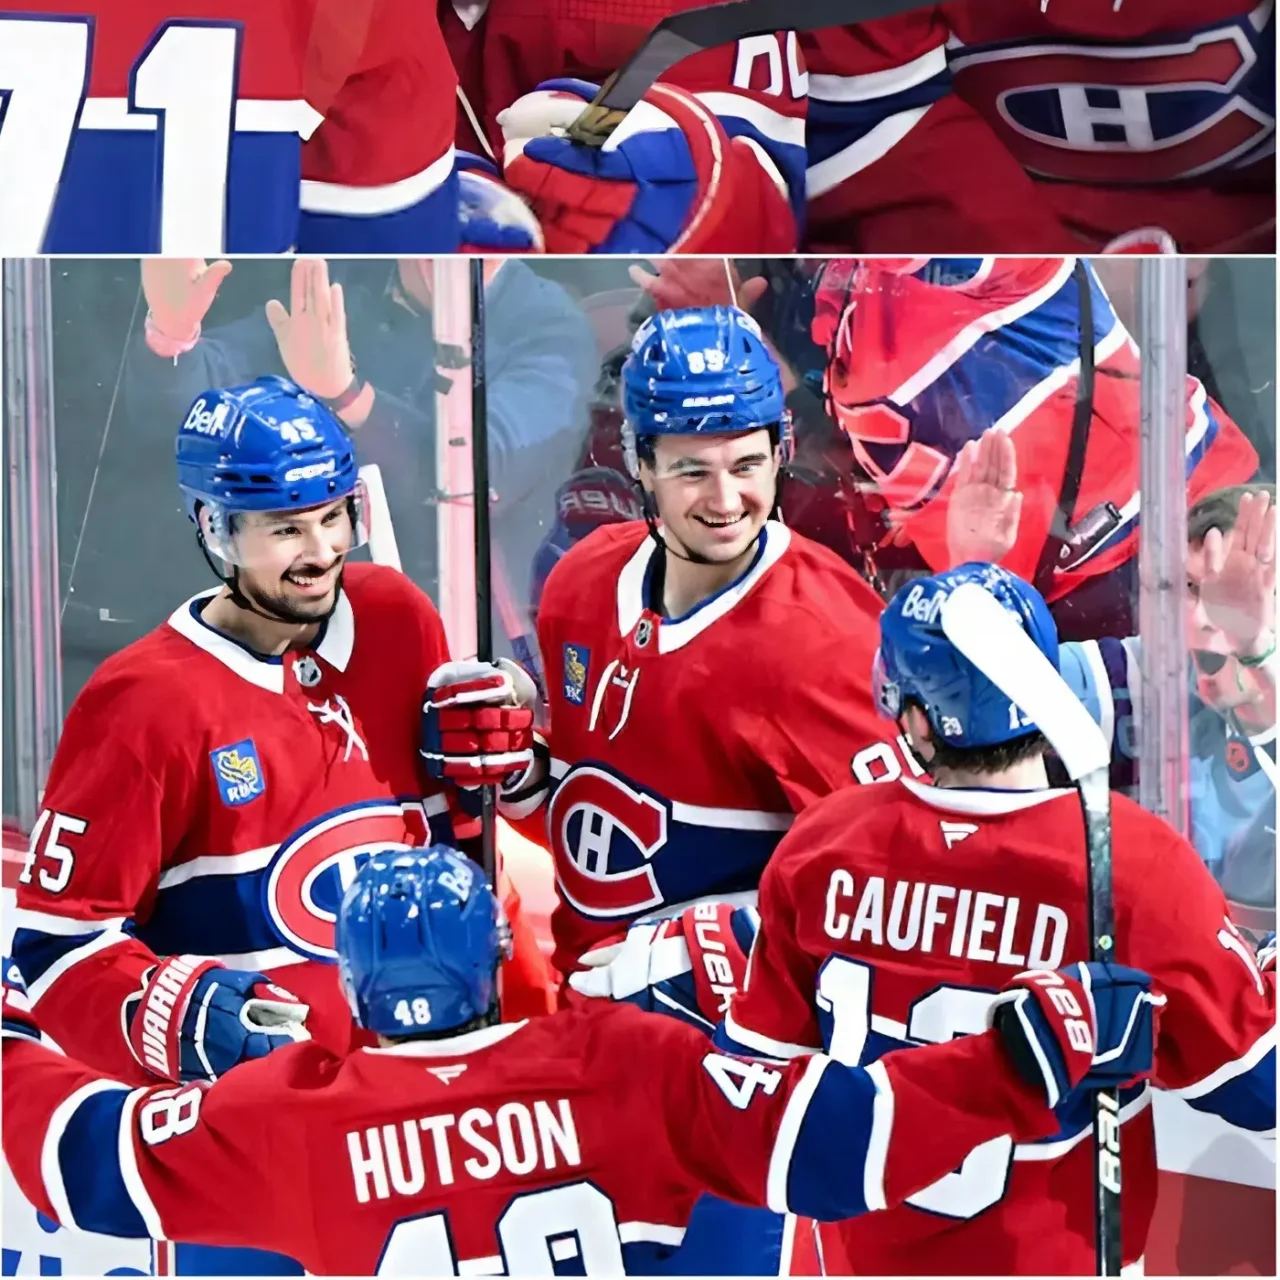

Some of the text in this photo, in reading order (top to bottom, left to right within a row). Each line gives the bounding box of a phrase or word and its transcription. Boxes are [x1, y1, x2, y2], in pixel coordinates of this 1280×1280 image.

[693, 902, 738, 1013] AUER
[824, 868, 1069, 971] CAUFIELD
[393, 997, 432, 1026] 48
[140, 1086, 203, 1146] 8
[701, 1051, 783, 1111] 4
[346, 1098, 583, 1204] HUTSON
